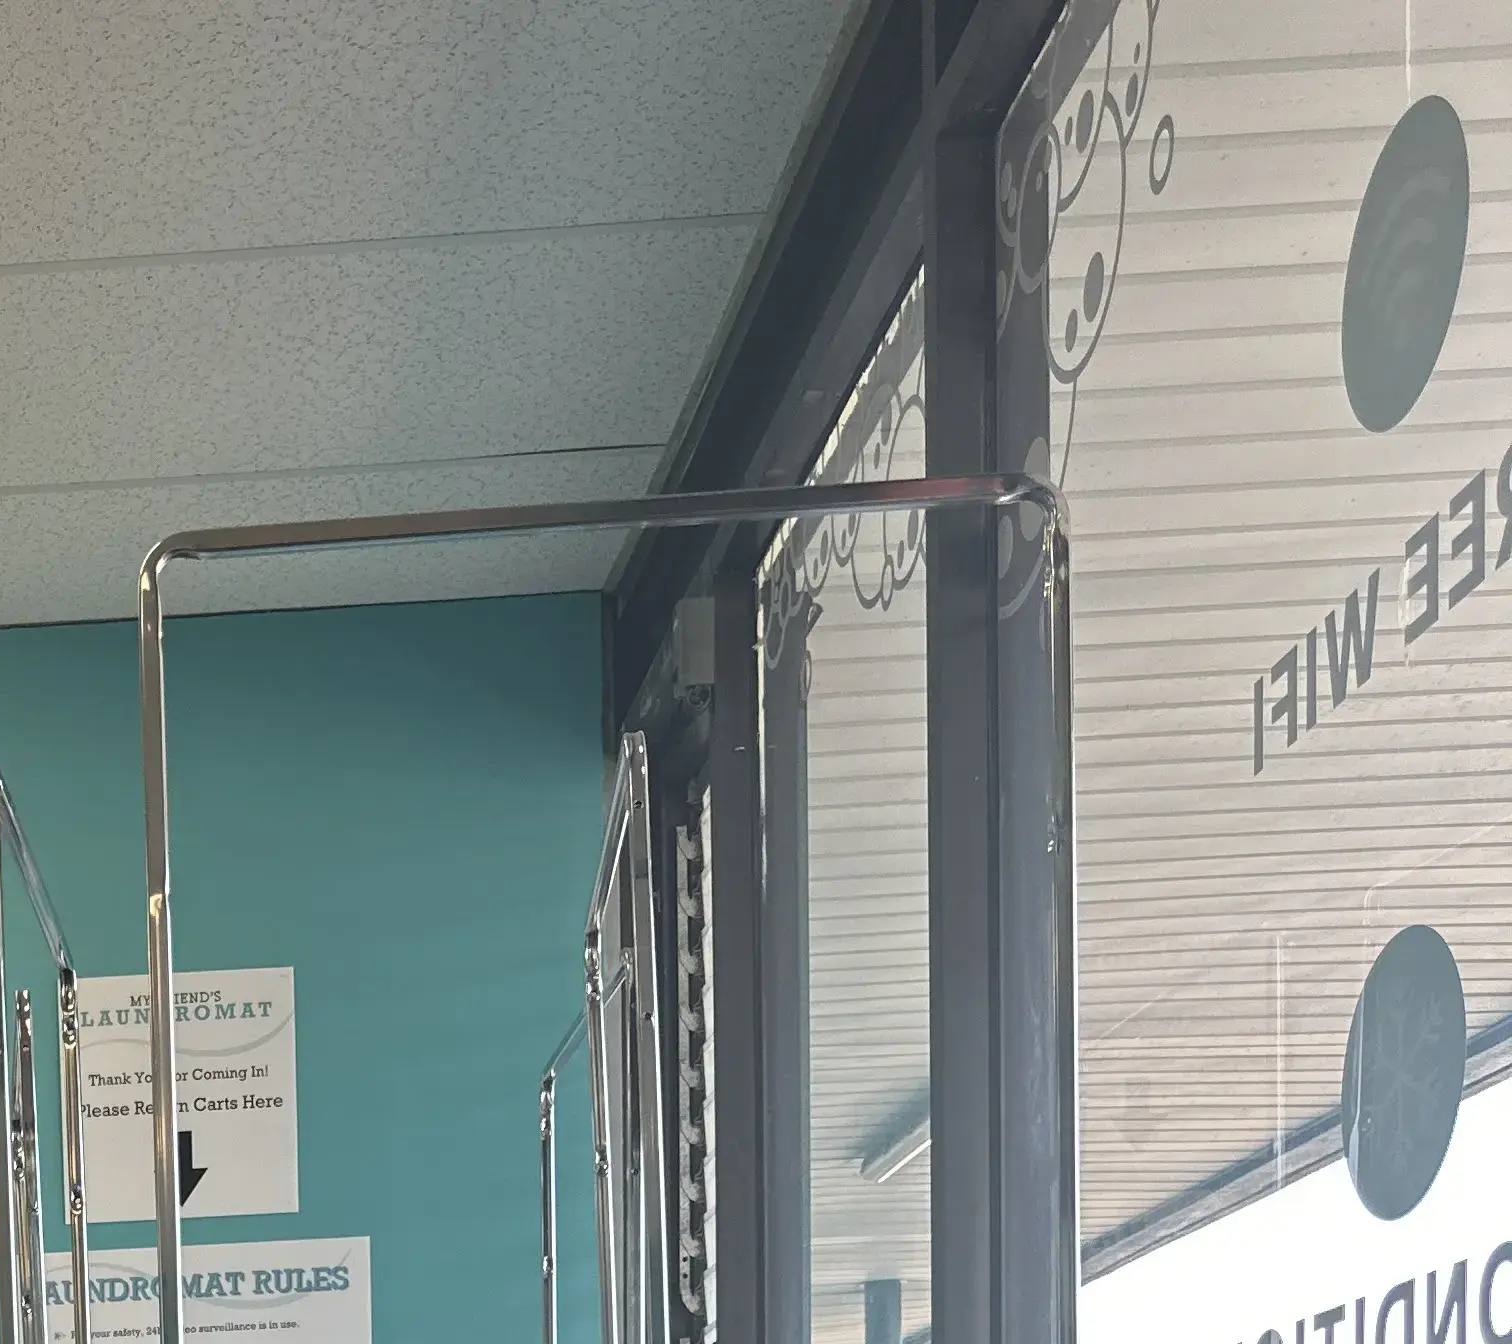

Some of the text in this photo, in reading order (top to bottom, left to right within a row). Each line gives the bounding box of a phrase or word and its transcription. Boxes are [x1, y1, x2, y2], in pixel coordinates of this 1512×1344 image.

[130, 990, 222, 1007] MY IEND'S
[80, 1001, 272, 1027] LAUNROMAT
[88, 1064, 269, 1086] Thank Yo or Coming In!
[134, 1100, 189, 1115] Ren
[193, 1097, 238, 1112] Carts
[242, 1094, 284, 1109] Here
[45, 1265, 350, 1306] AUNDRMAT RULES
[198, 1322, 256, 1333] surveillance
[258, 1321, 267, 1330] is
[269, 1320, 278, 1329] in
